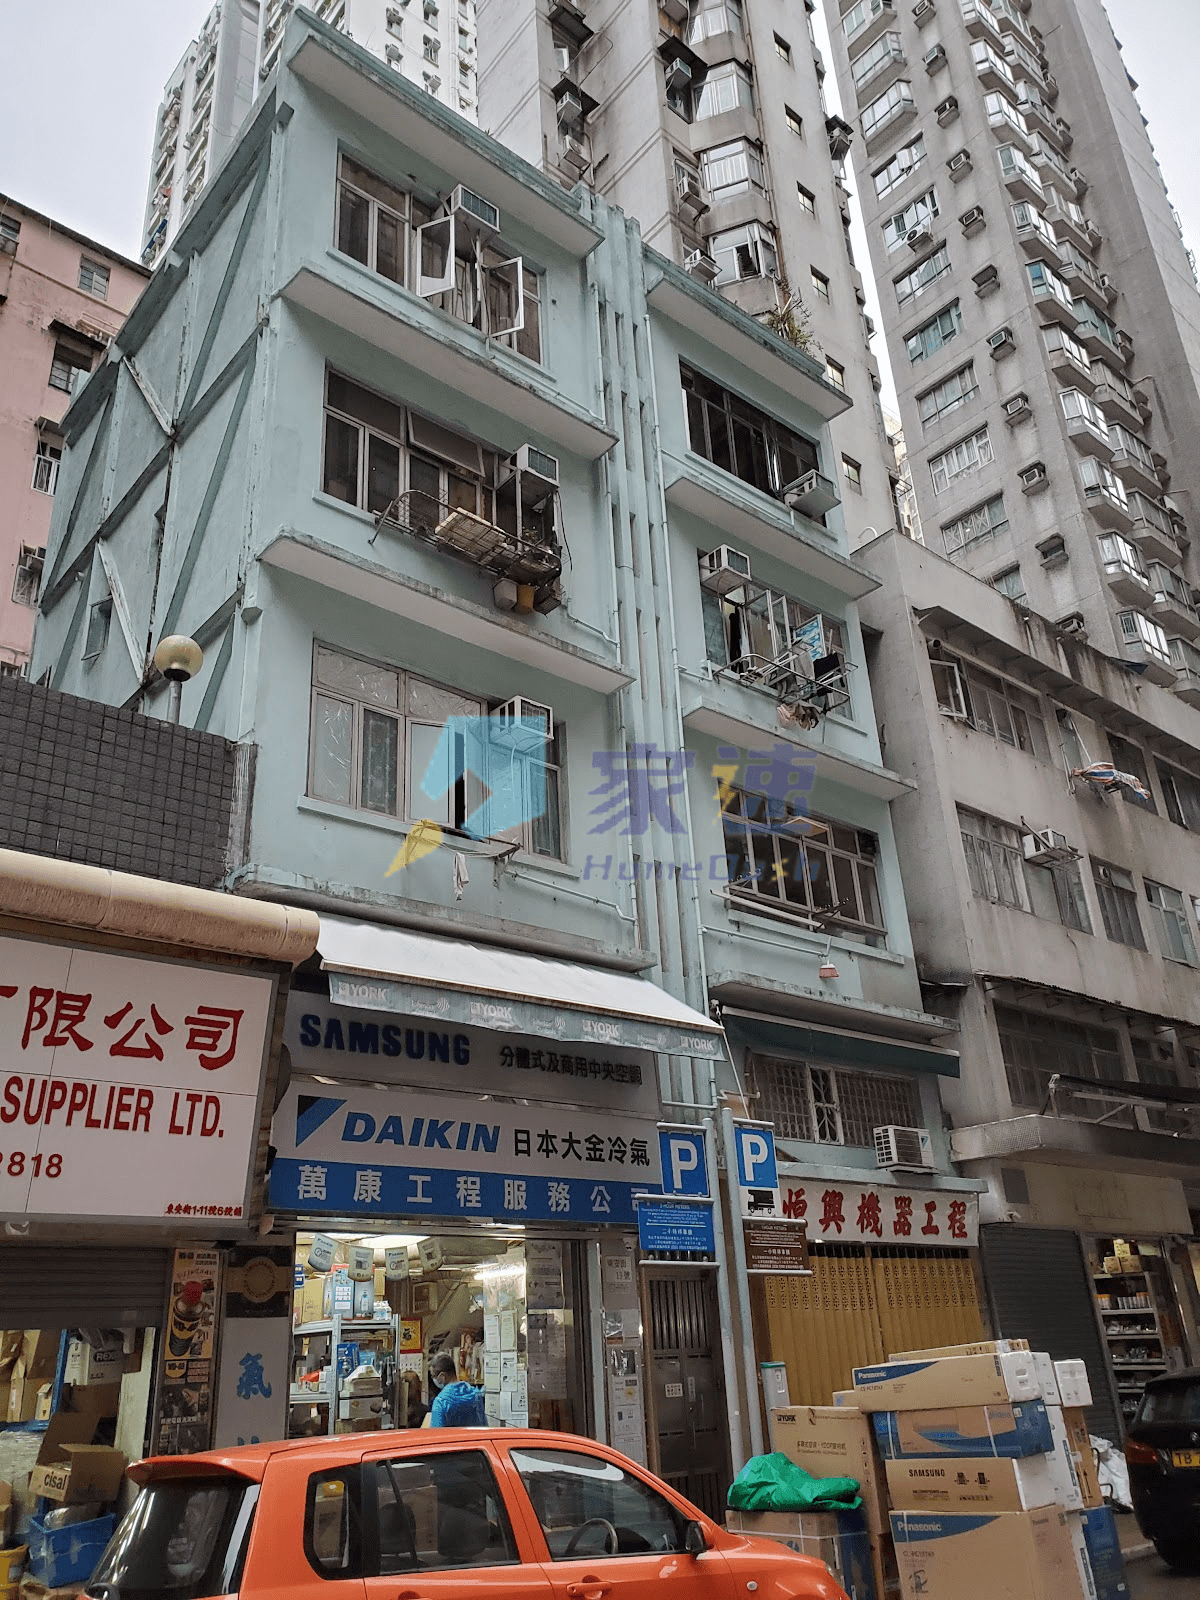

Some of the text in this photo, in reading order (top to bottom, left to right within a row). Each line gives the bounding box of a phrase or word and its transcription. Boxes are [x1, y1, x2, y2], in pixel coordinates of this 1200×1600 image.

[351, 984, 387, 1000] YORK
[481, 1002, 513, 1018] YORK
[0, 986, 244, 1071] 限公司
[300, 1014, 470, 1066] SAMSUNG
[590, 1020, 621, 1036] YORK
[687, 1037, 715, 1050] YORK
[500, 1046, 642, 1085] 分體式及商用中央空調
[1, 1075, 224, 1138] SUPPLIER LTD.
[341, 1111, 500, 1153] DAIKIN
[514, 1129, 650, 1167] 日本大金冷氣
[0, 1151, 63, 1178] 818
[669, 1139, 698, 1189] P
[741, 1134, 768, 1181] P
[858, 1370, 887, 1379] Panasonic
[909, 1468, 945, 1477] SAMSUNG
[897, 1521, 942, 1532] Panasonic
